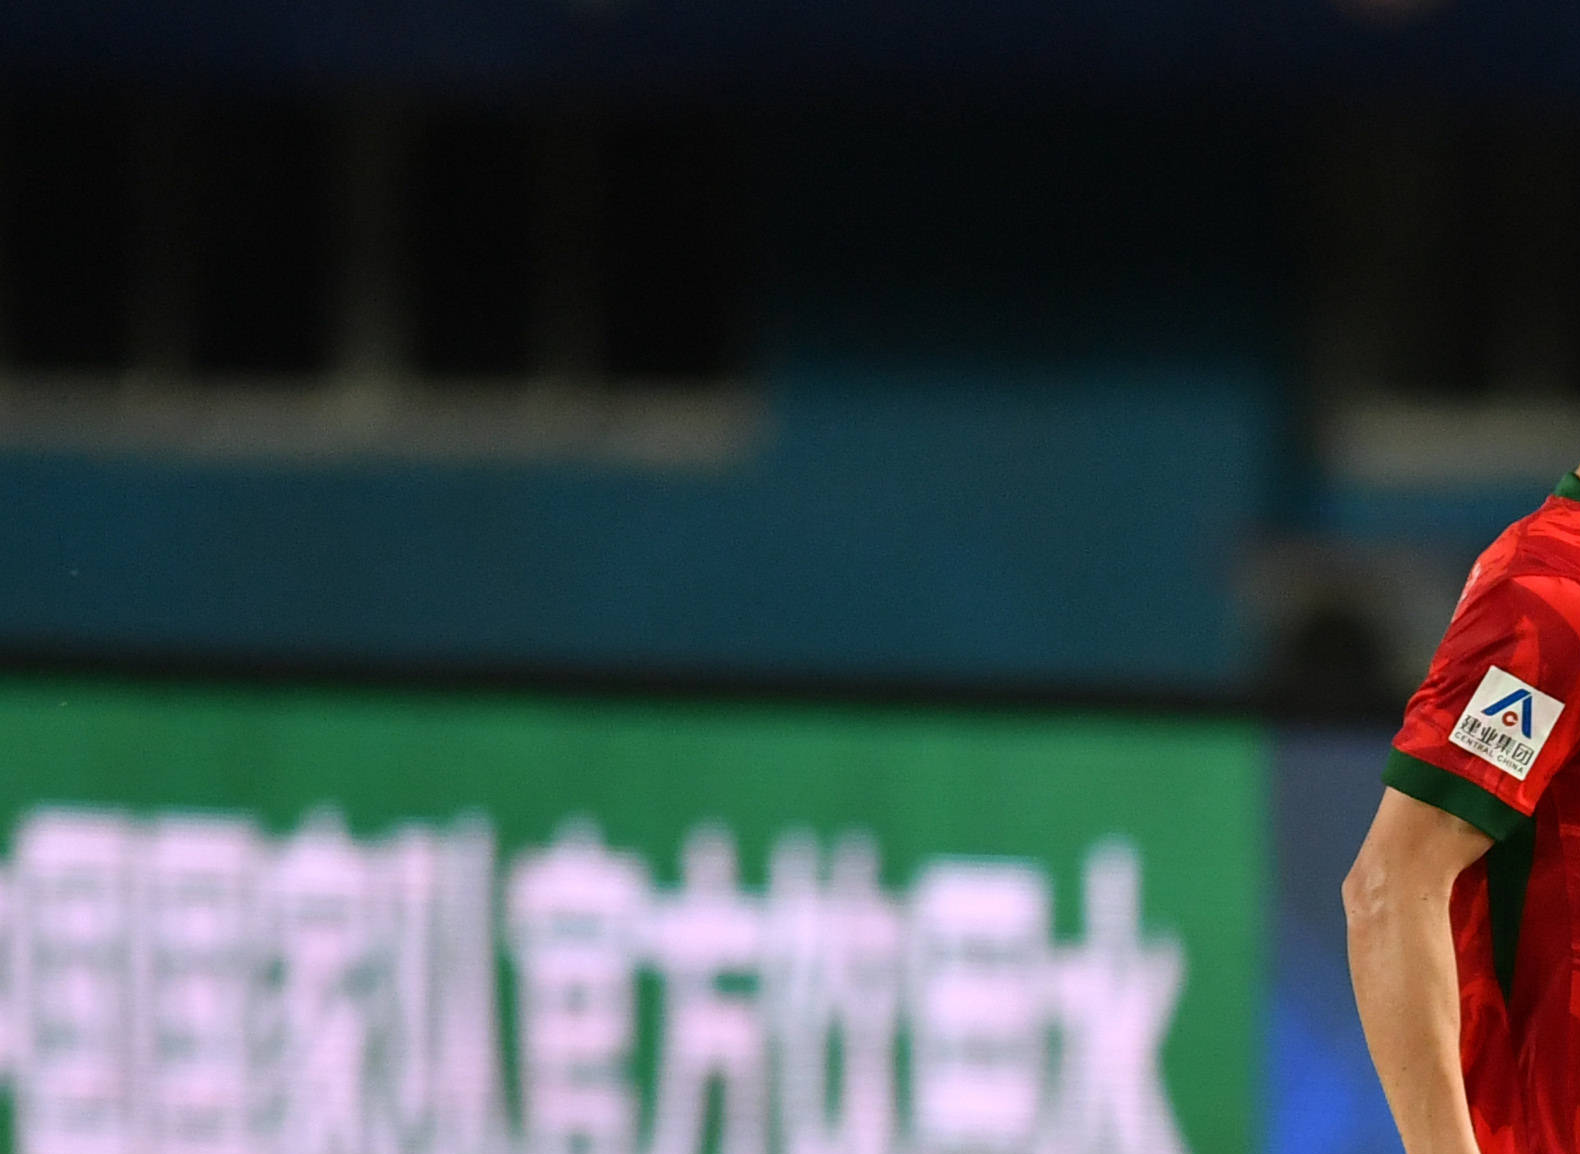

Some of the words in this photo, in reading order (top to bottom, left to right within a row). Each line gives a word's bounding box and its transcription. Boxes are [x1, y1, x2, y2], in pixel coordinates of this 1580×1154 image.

[1454, 731, 1495, 758] CENTRAL
[1496, 753, 1524, 774] CHINA
[1460, 715, 1535, 766] 建业集团
